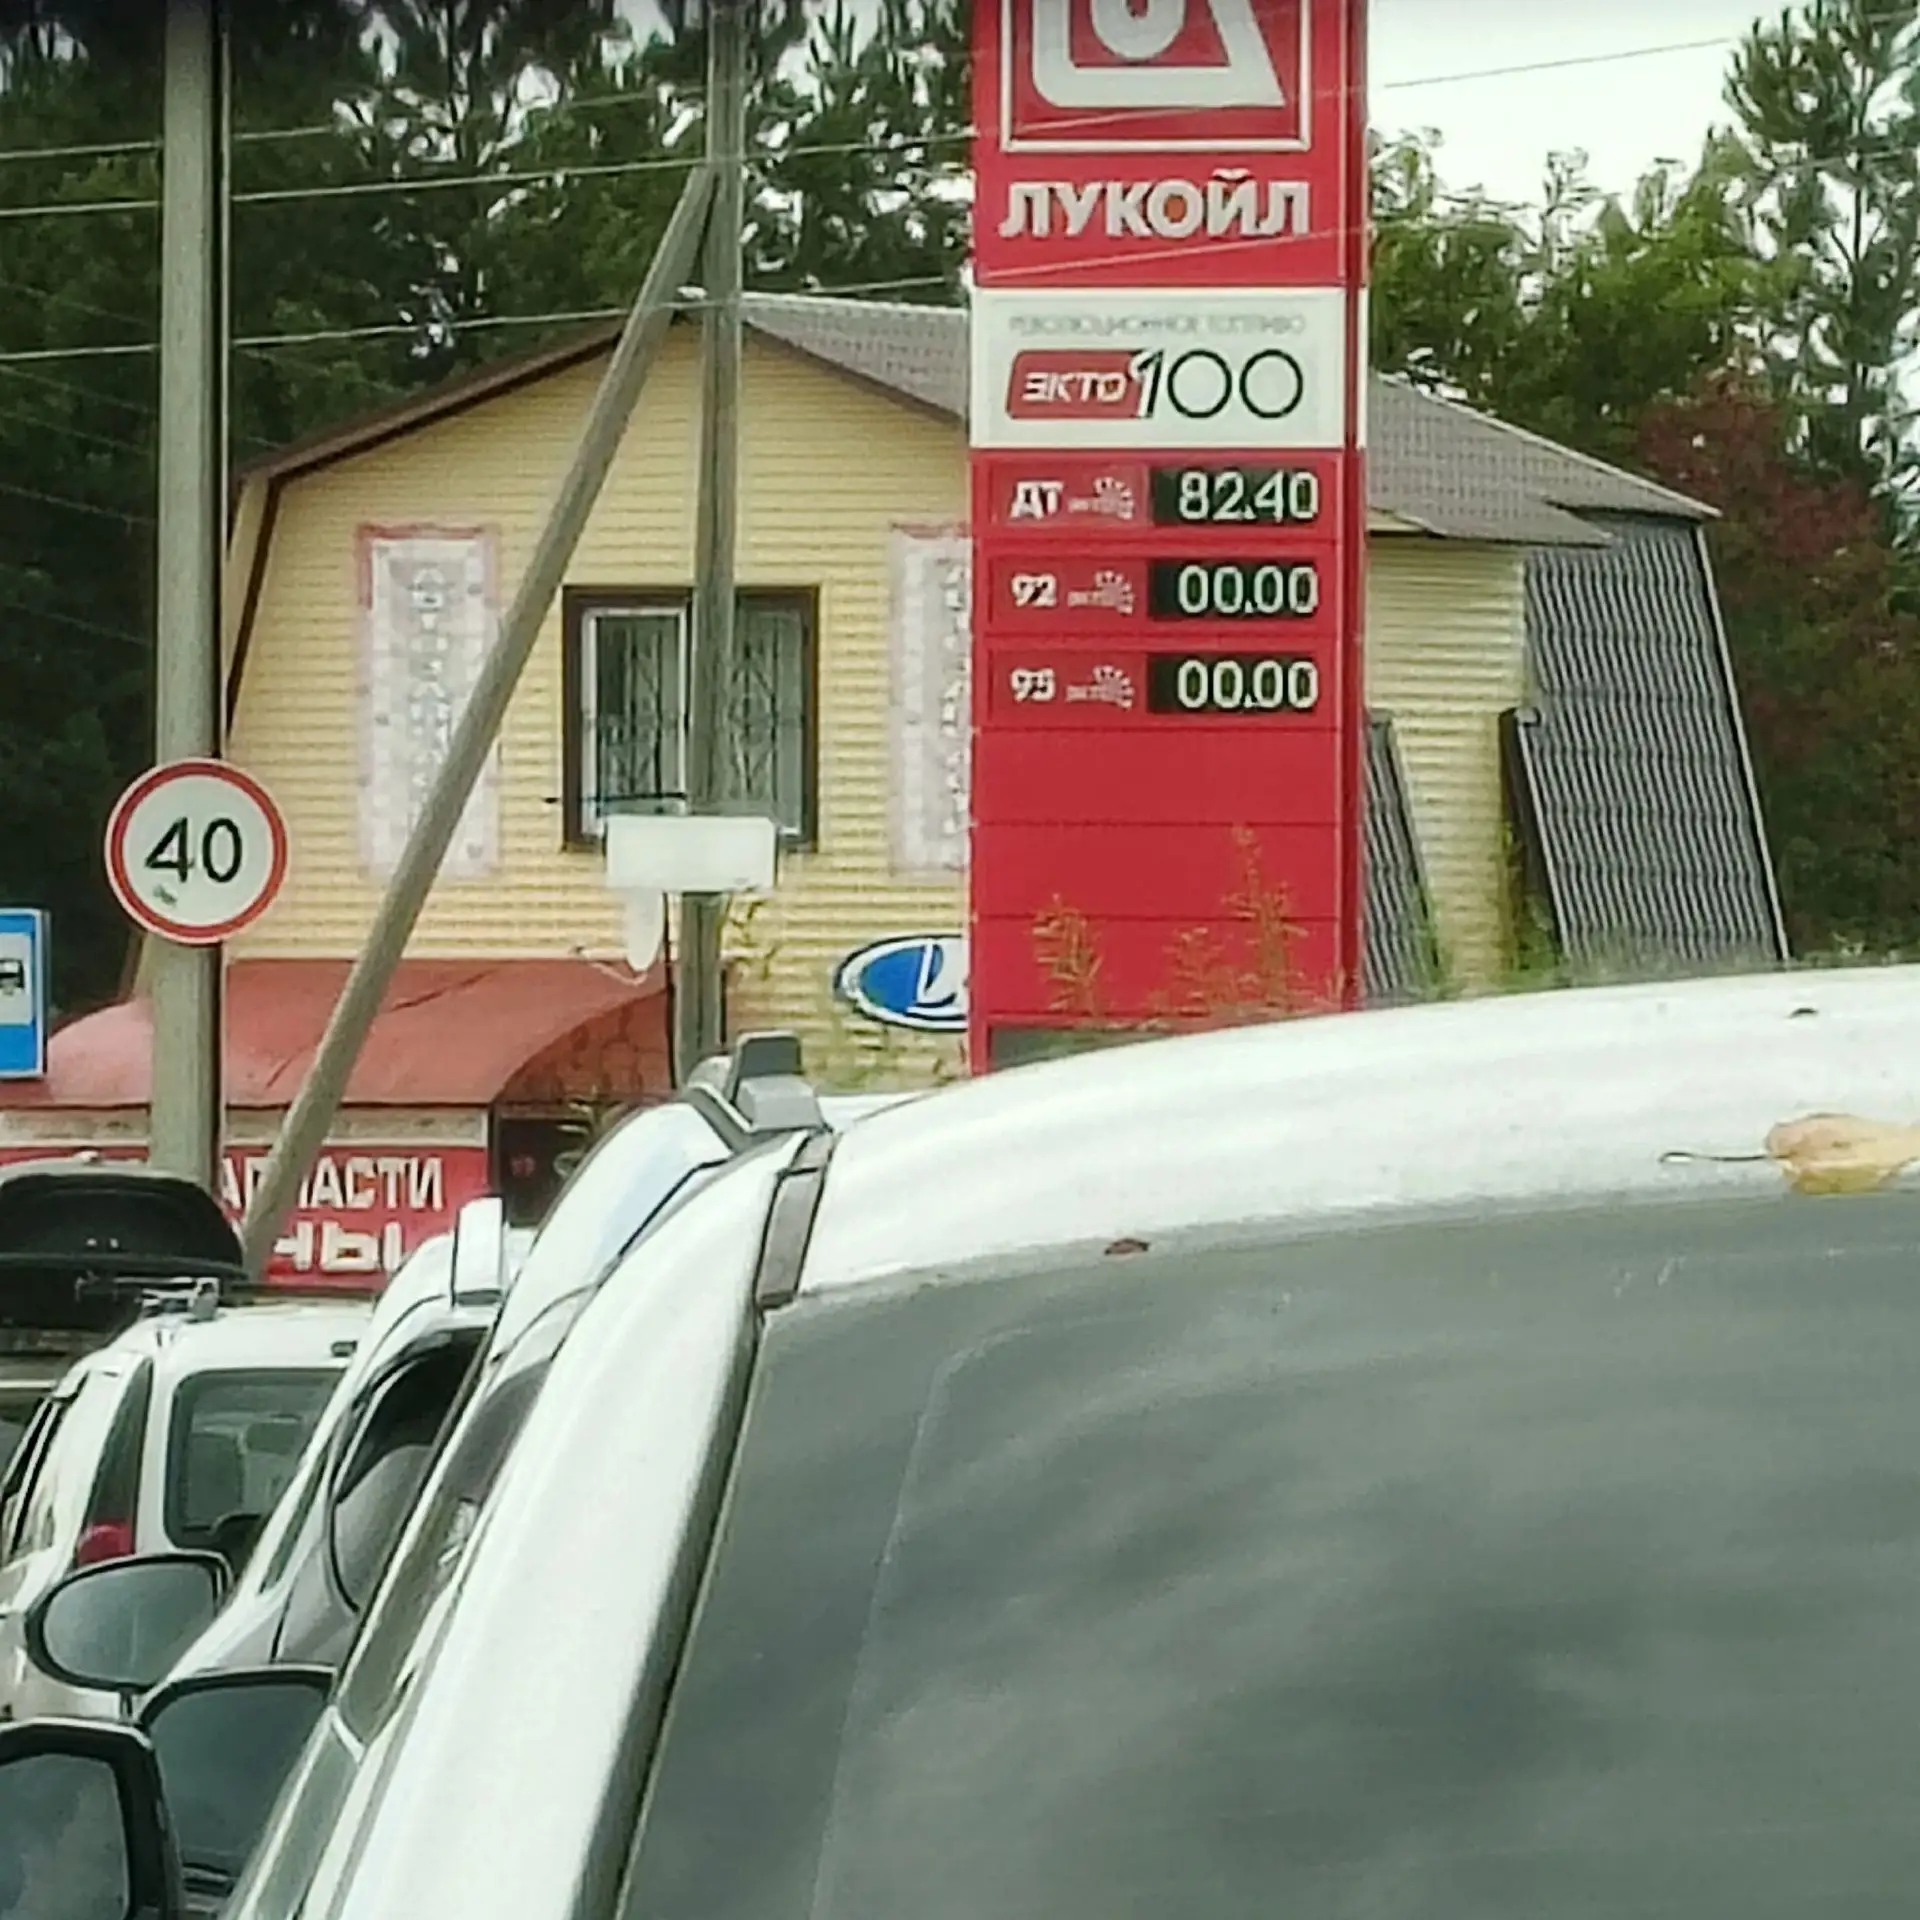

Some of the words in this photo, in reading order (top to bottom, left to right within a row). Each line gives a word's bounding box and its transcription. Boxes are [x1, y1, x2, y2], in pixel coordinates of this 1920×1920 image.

[998, 168, 1311, 239] ЛУКОЙЛ
[1127, 348, 1304, 420] 100
[1178, 470, 1319, 523] 82.40
[1010, 573, 1058, 608] 92
[1178, 564, 1319, 615] 00.00
[1177, 659, 1319, 709] 00.00
[144, 816, 243, 884] 40
